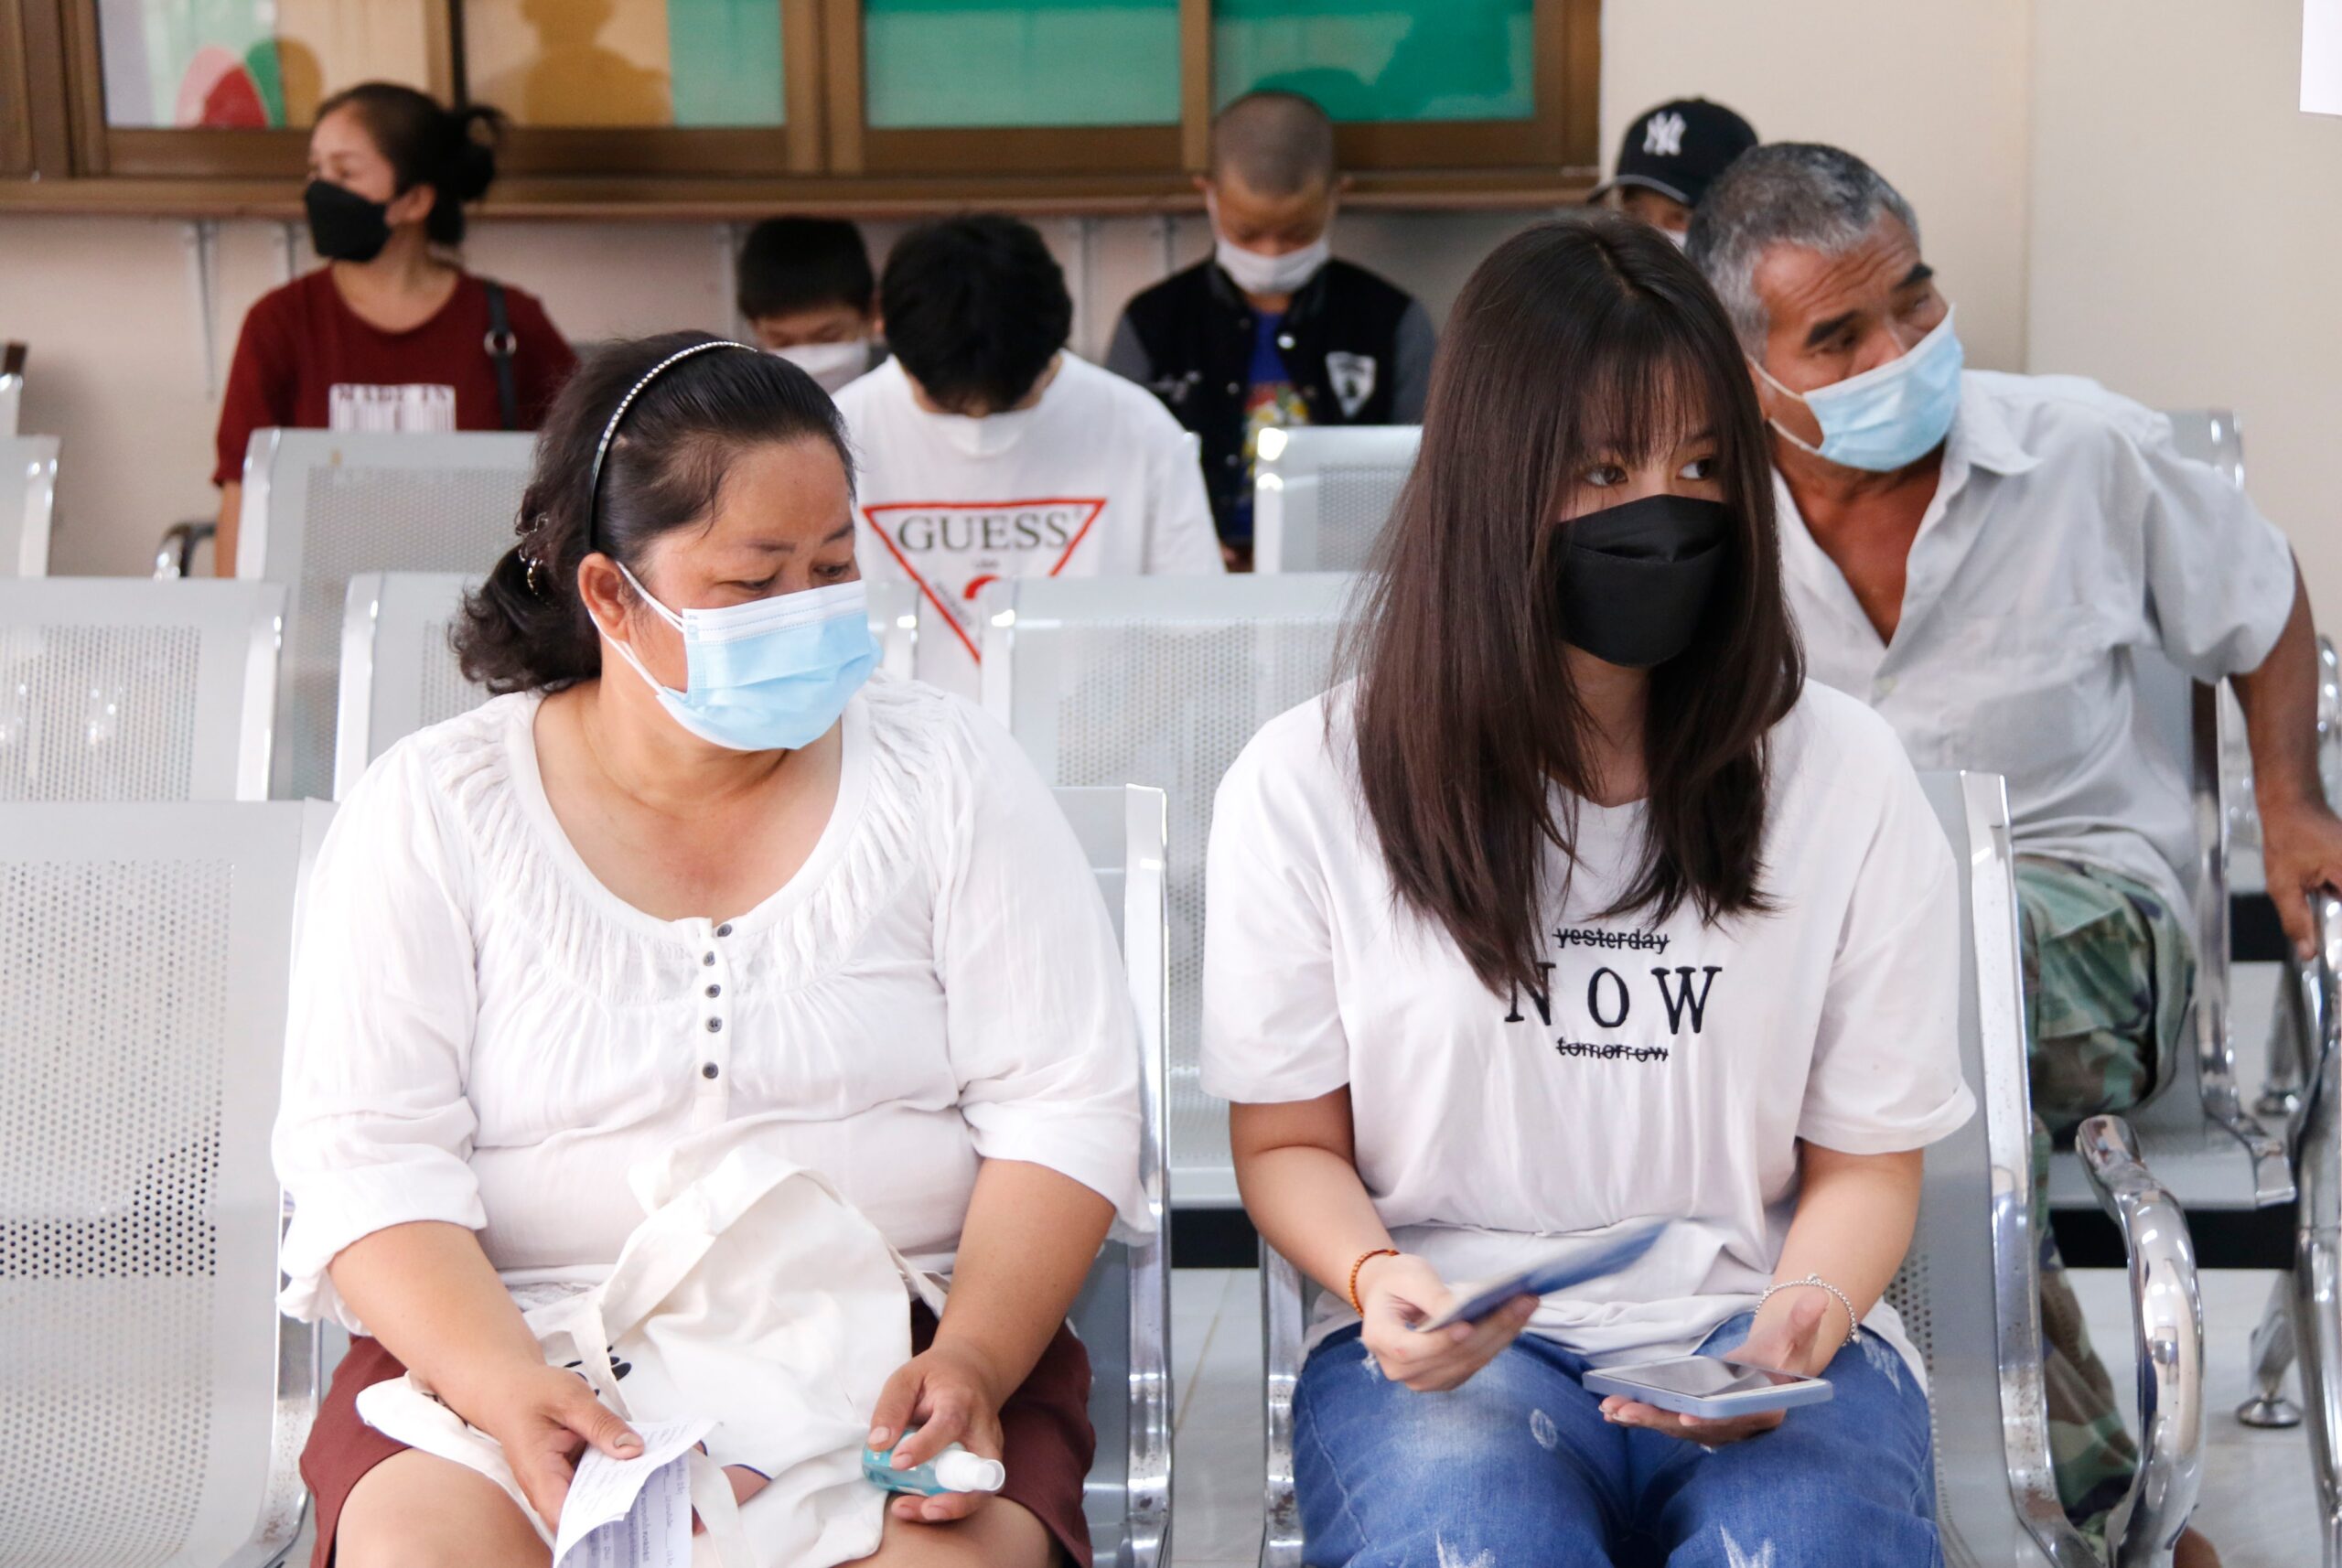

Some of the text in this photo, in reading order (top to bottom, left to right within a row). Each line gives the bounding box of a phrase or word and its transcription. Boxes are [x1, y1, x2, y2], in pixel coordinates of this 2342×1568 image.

[1643, 112, 1687, 156] NY
[897, 512, 1069, 553] GUESS
[1555, 927, 1670, 954] yesterday
[1556, 1036, 1669, 1062] tomorrow
